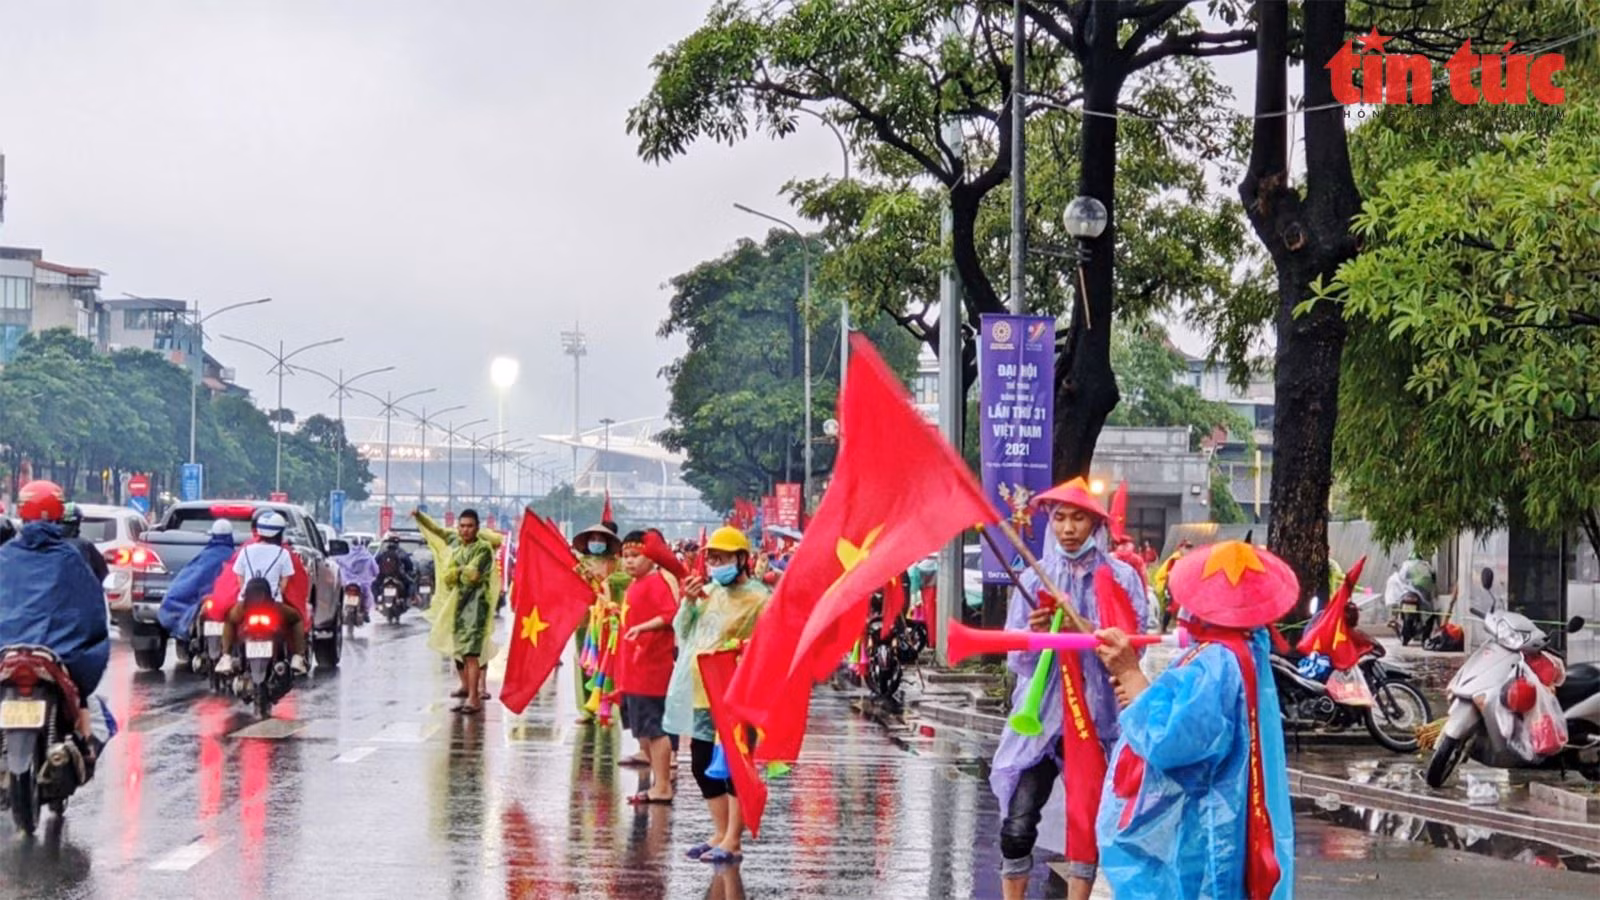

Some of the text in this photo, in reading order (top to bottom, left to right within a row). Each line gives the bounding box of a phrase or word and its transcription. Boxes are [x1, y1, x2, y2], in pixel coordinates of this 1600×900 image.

[1034, 407, 1046, 420] 31
[992, 422, 1042, 440] VIỆT NAM
[1005, 443, 1029, 456] 2021
